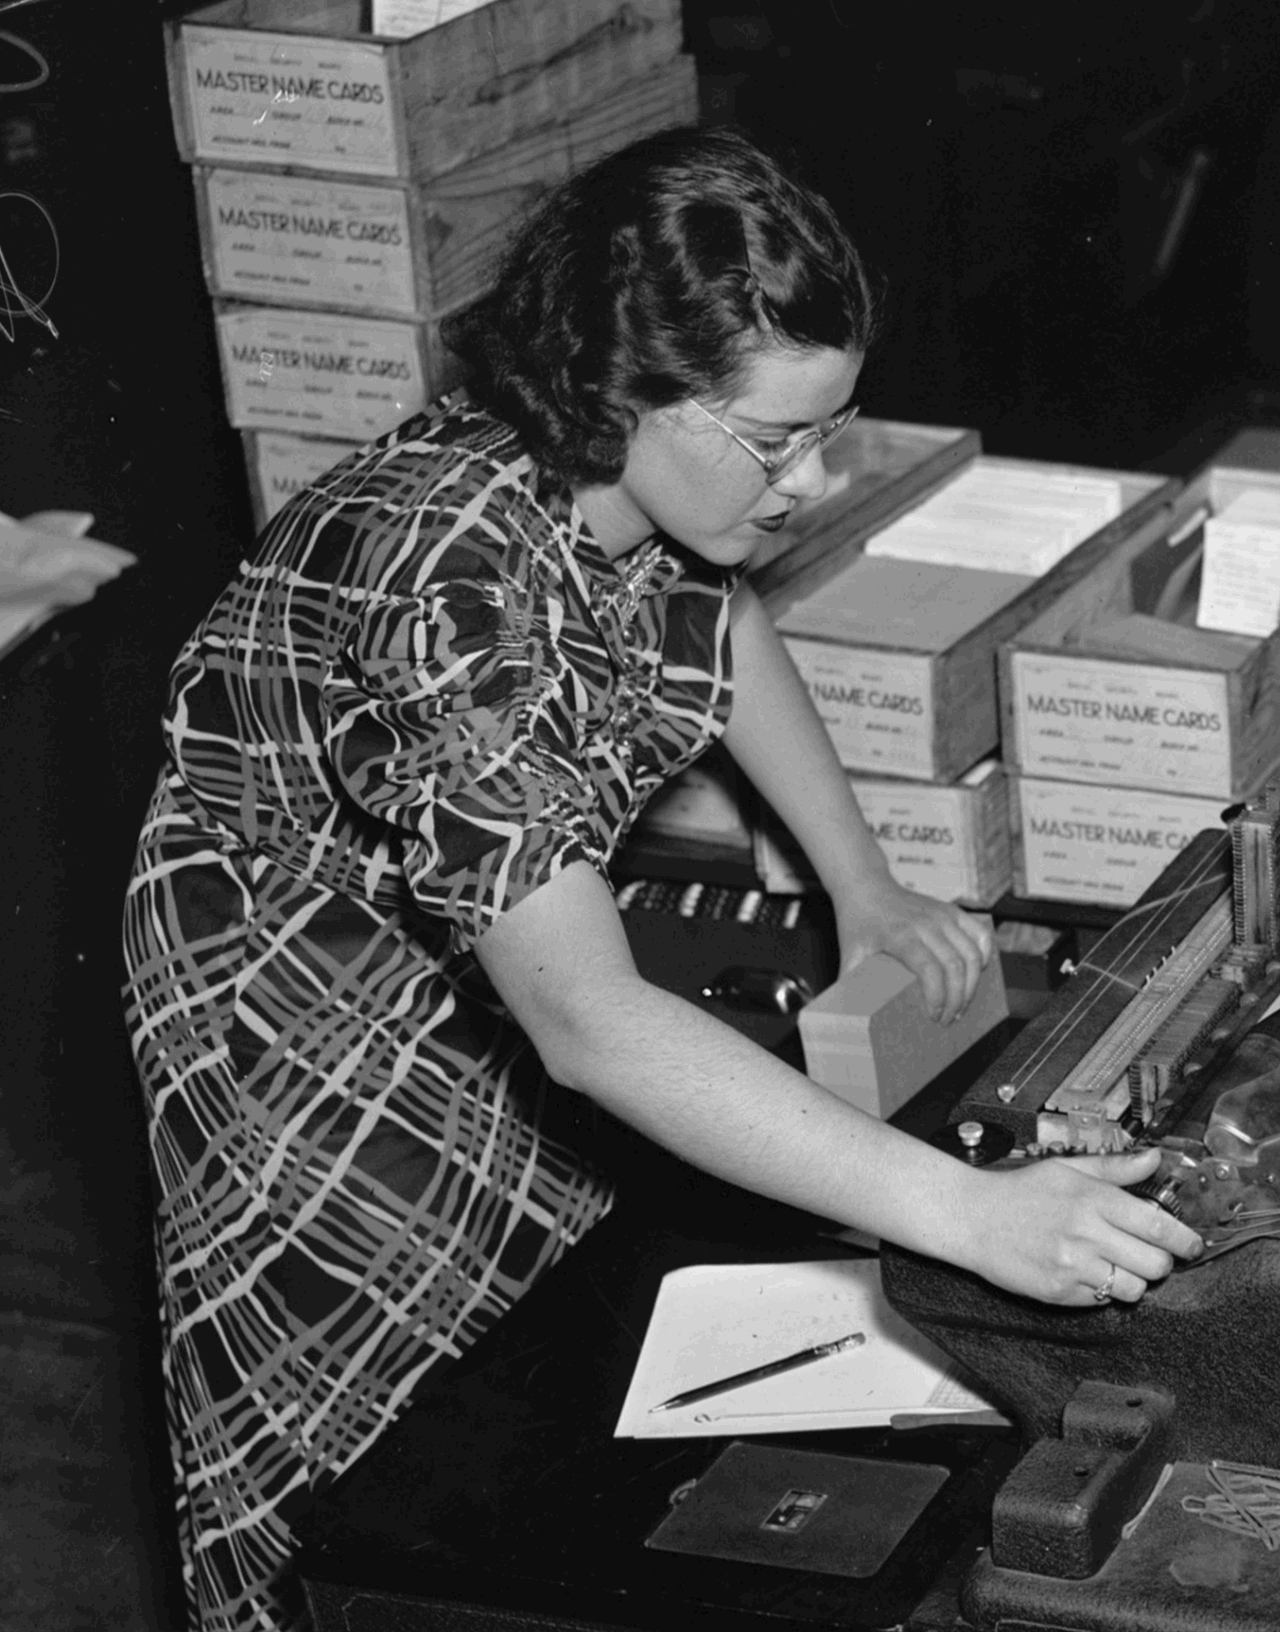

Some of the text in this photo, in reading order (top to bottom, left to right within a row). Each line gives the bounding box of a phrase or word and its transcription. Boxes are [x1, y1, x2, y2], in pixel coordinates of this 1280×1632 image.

[196, 68, 385, 105] MASTER NAME CARDS
[218, 205, 402, 246] MASTER NAME CARDS
[302, 351, 354, 376] NAME
[355, 355, 411, 381] CARDS
[813, 682, 924, 716] NAME CARDS
[1026, 693, 1222, 733] MASTER NAME CARDS
[897, 823, 955, 846] CARDS
[1029, 817, 1104, 844] MASTER
[1107, 826, 1163, 849] NAME
